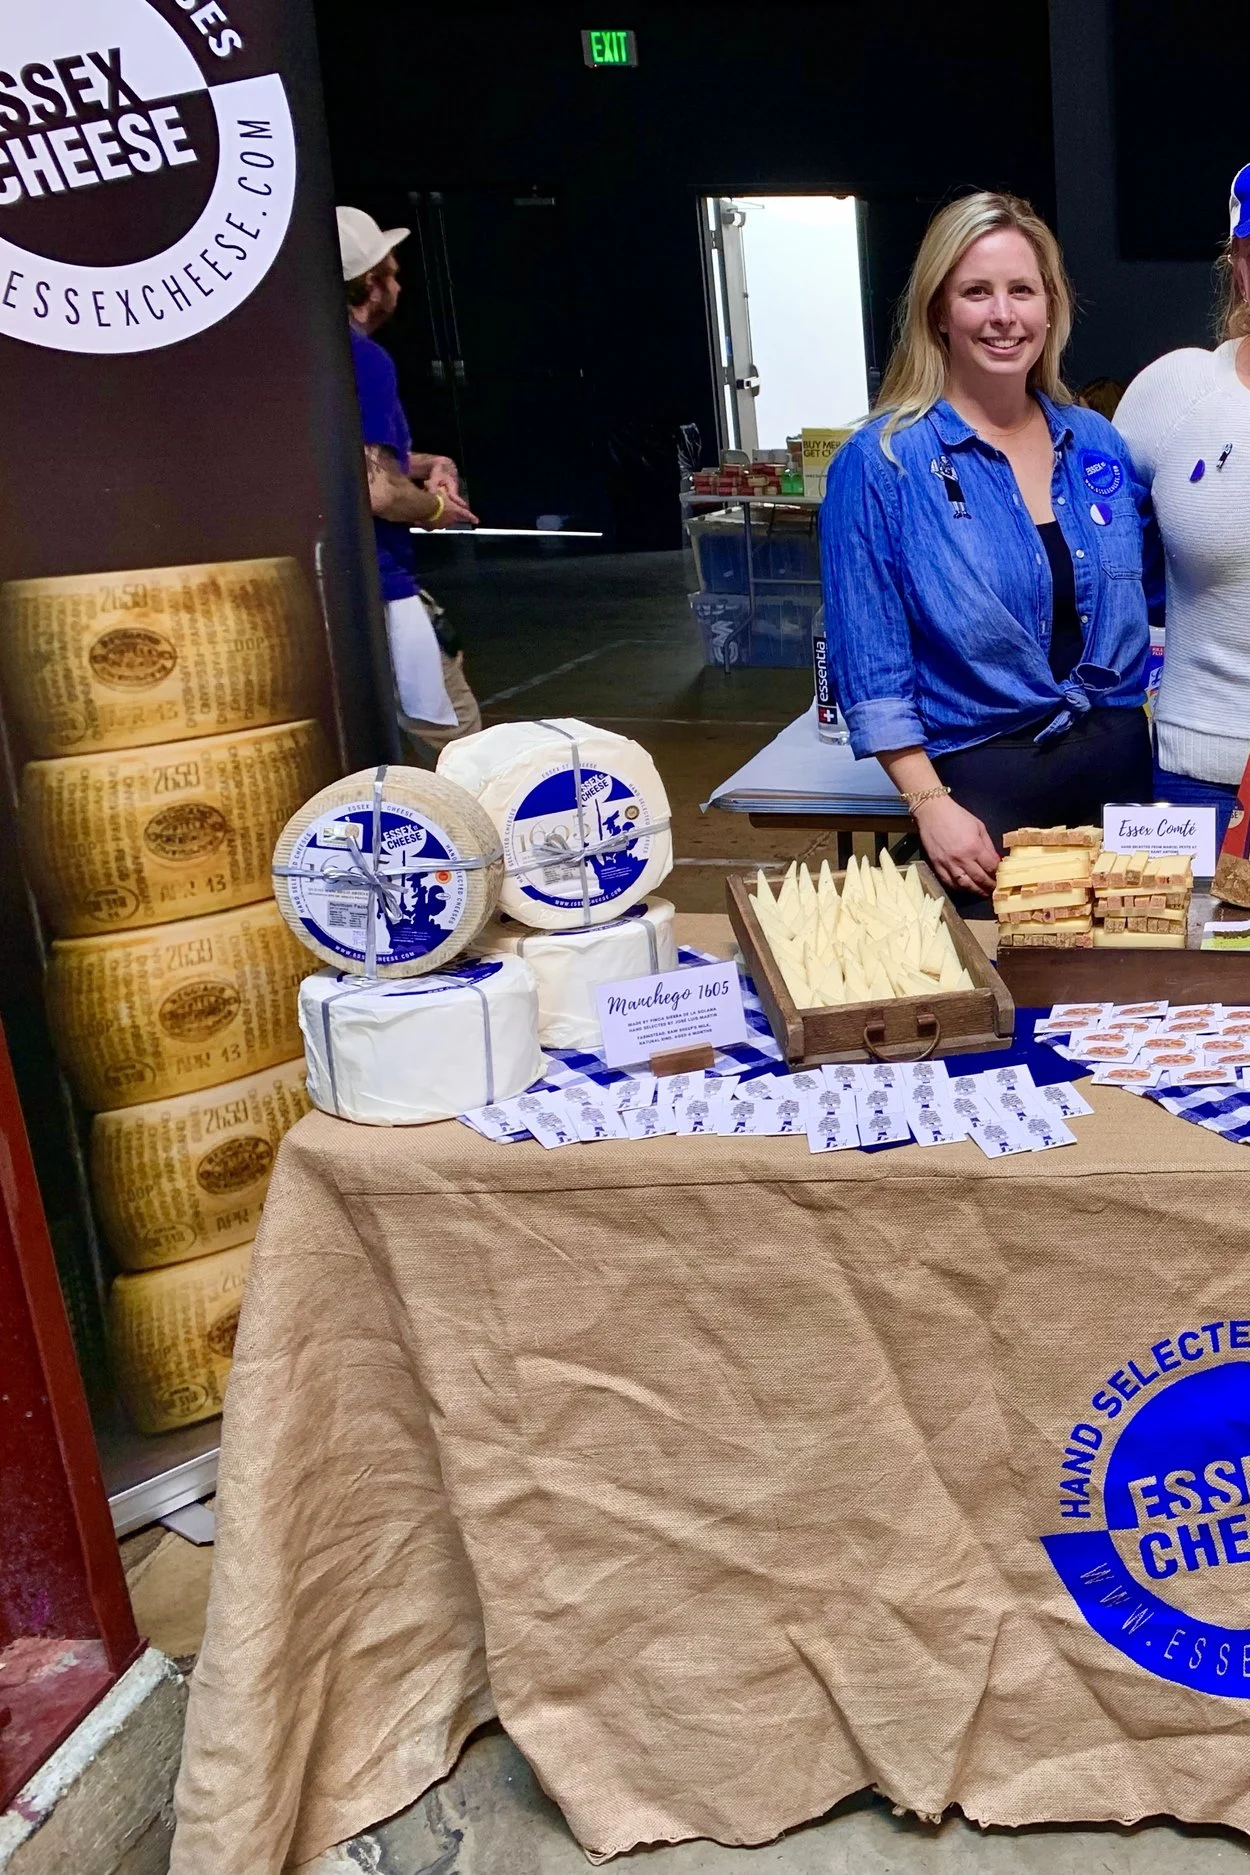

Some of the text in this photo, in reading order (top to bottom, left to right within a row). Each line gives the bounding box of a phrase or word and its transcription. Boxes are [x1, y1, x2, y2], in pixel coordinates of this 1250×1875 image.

[175, 0, 243, 58] ES
[591, 31, 627, 62] EXIT
[803, 440, 821, 449] BUY
[816, 641, 838, 702] essentia
[581, 779, 609, 803] CHEESE
[386, 805, 413, 818] CHEESE
[383, 824, 413, 840] ESSEX
[1118, 819, 1197, 837] Essex Comté
[387, 832, 422, 849] CHEESE
[607, 980, 729, 1016] Manchego 1605
[643, 1022, 666, 1030] SELECTED
[204, 1100, 248, 1134] 2659
[1060, 1422, 1102, 1518] HAND
